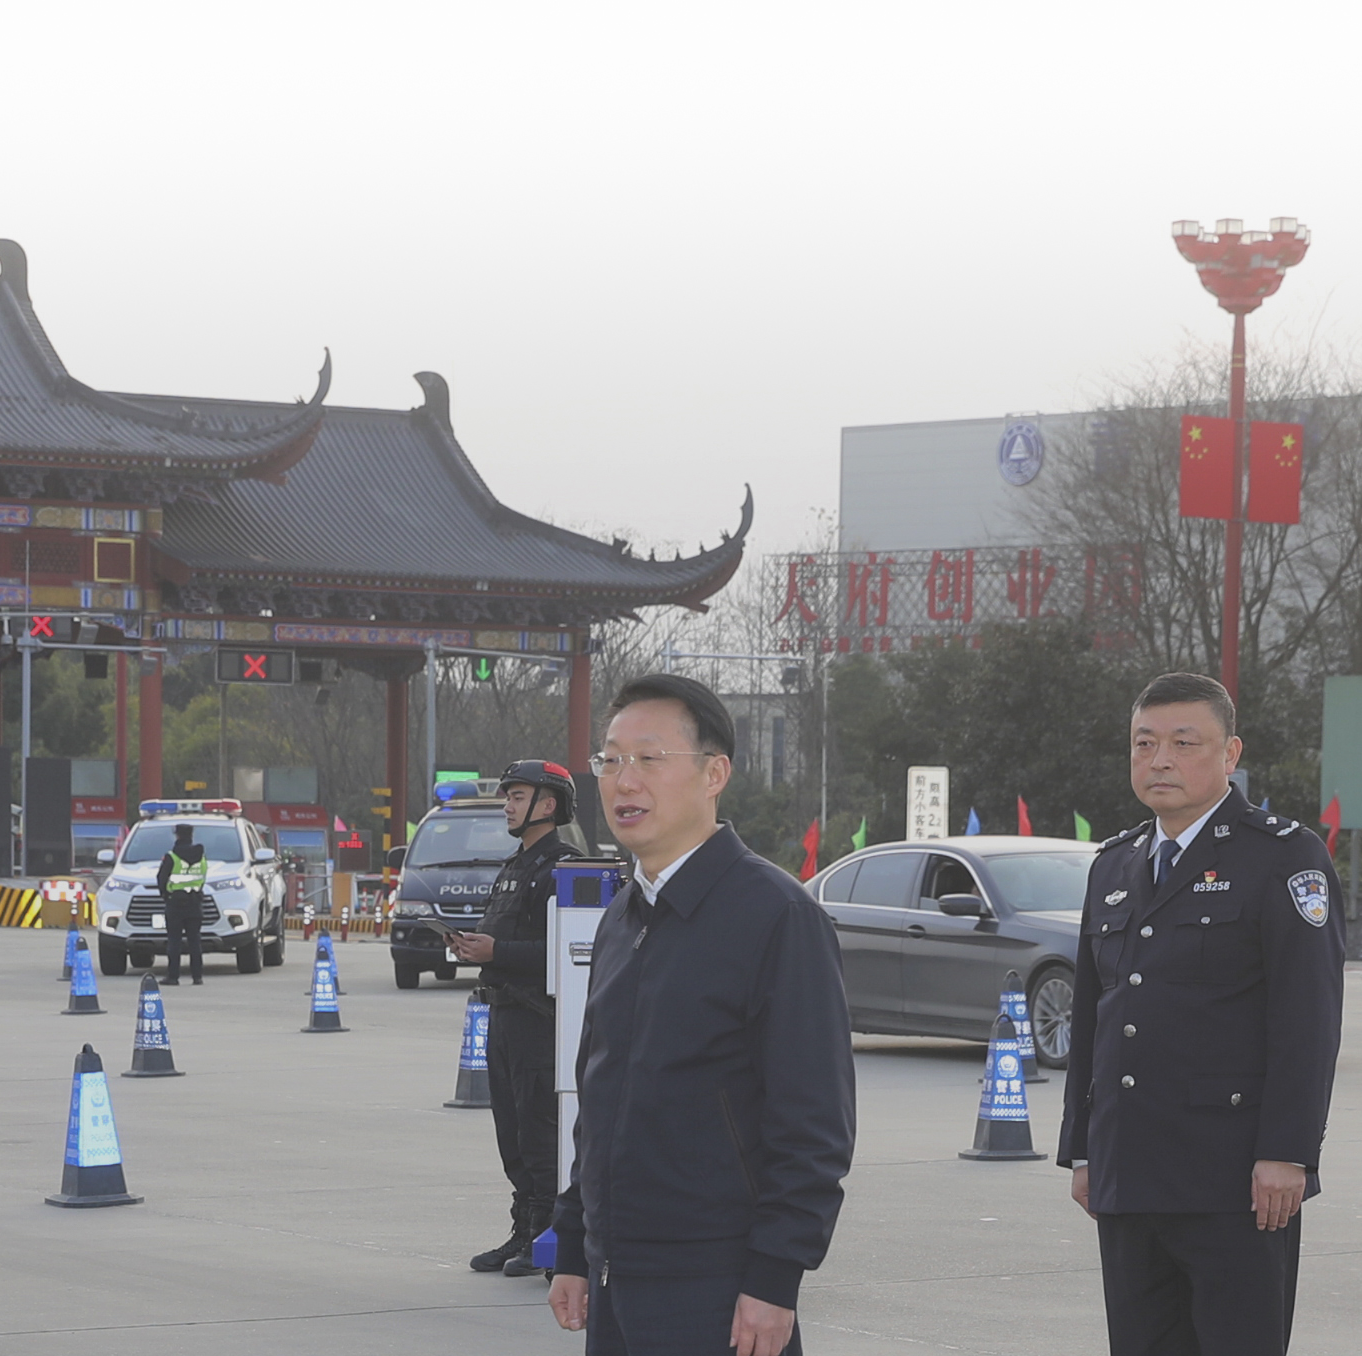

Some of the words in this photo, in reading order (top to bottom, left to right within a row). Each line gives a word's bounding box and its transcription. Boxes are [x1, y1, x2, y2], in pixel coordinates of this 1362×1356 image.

[440, 884, 493, 896] POLIC
[1193, 881, 1231, 892] 059258
[994, 1094, 1023, 1105] POLICE
